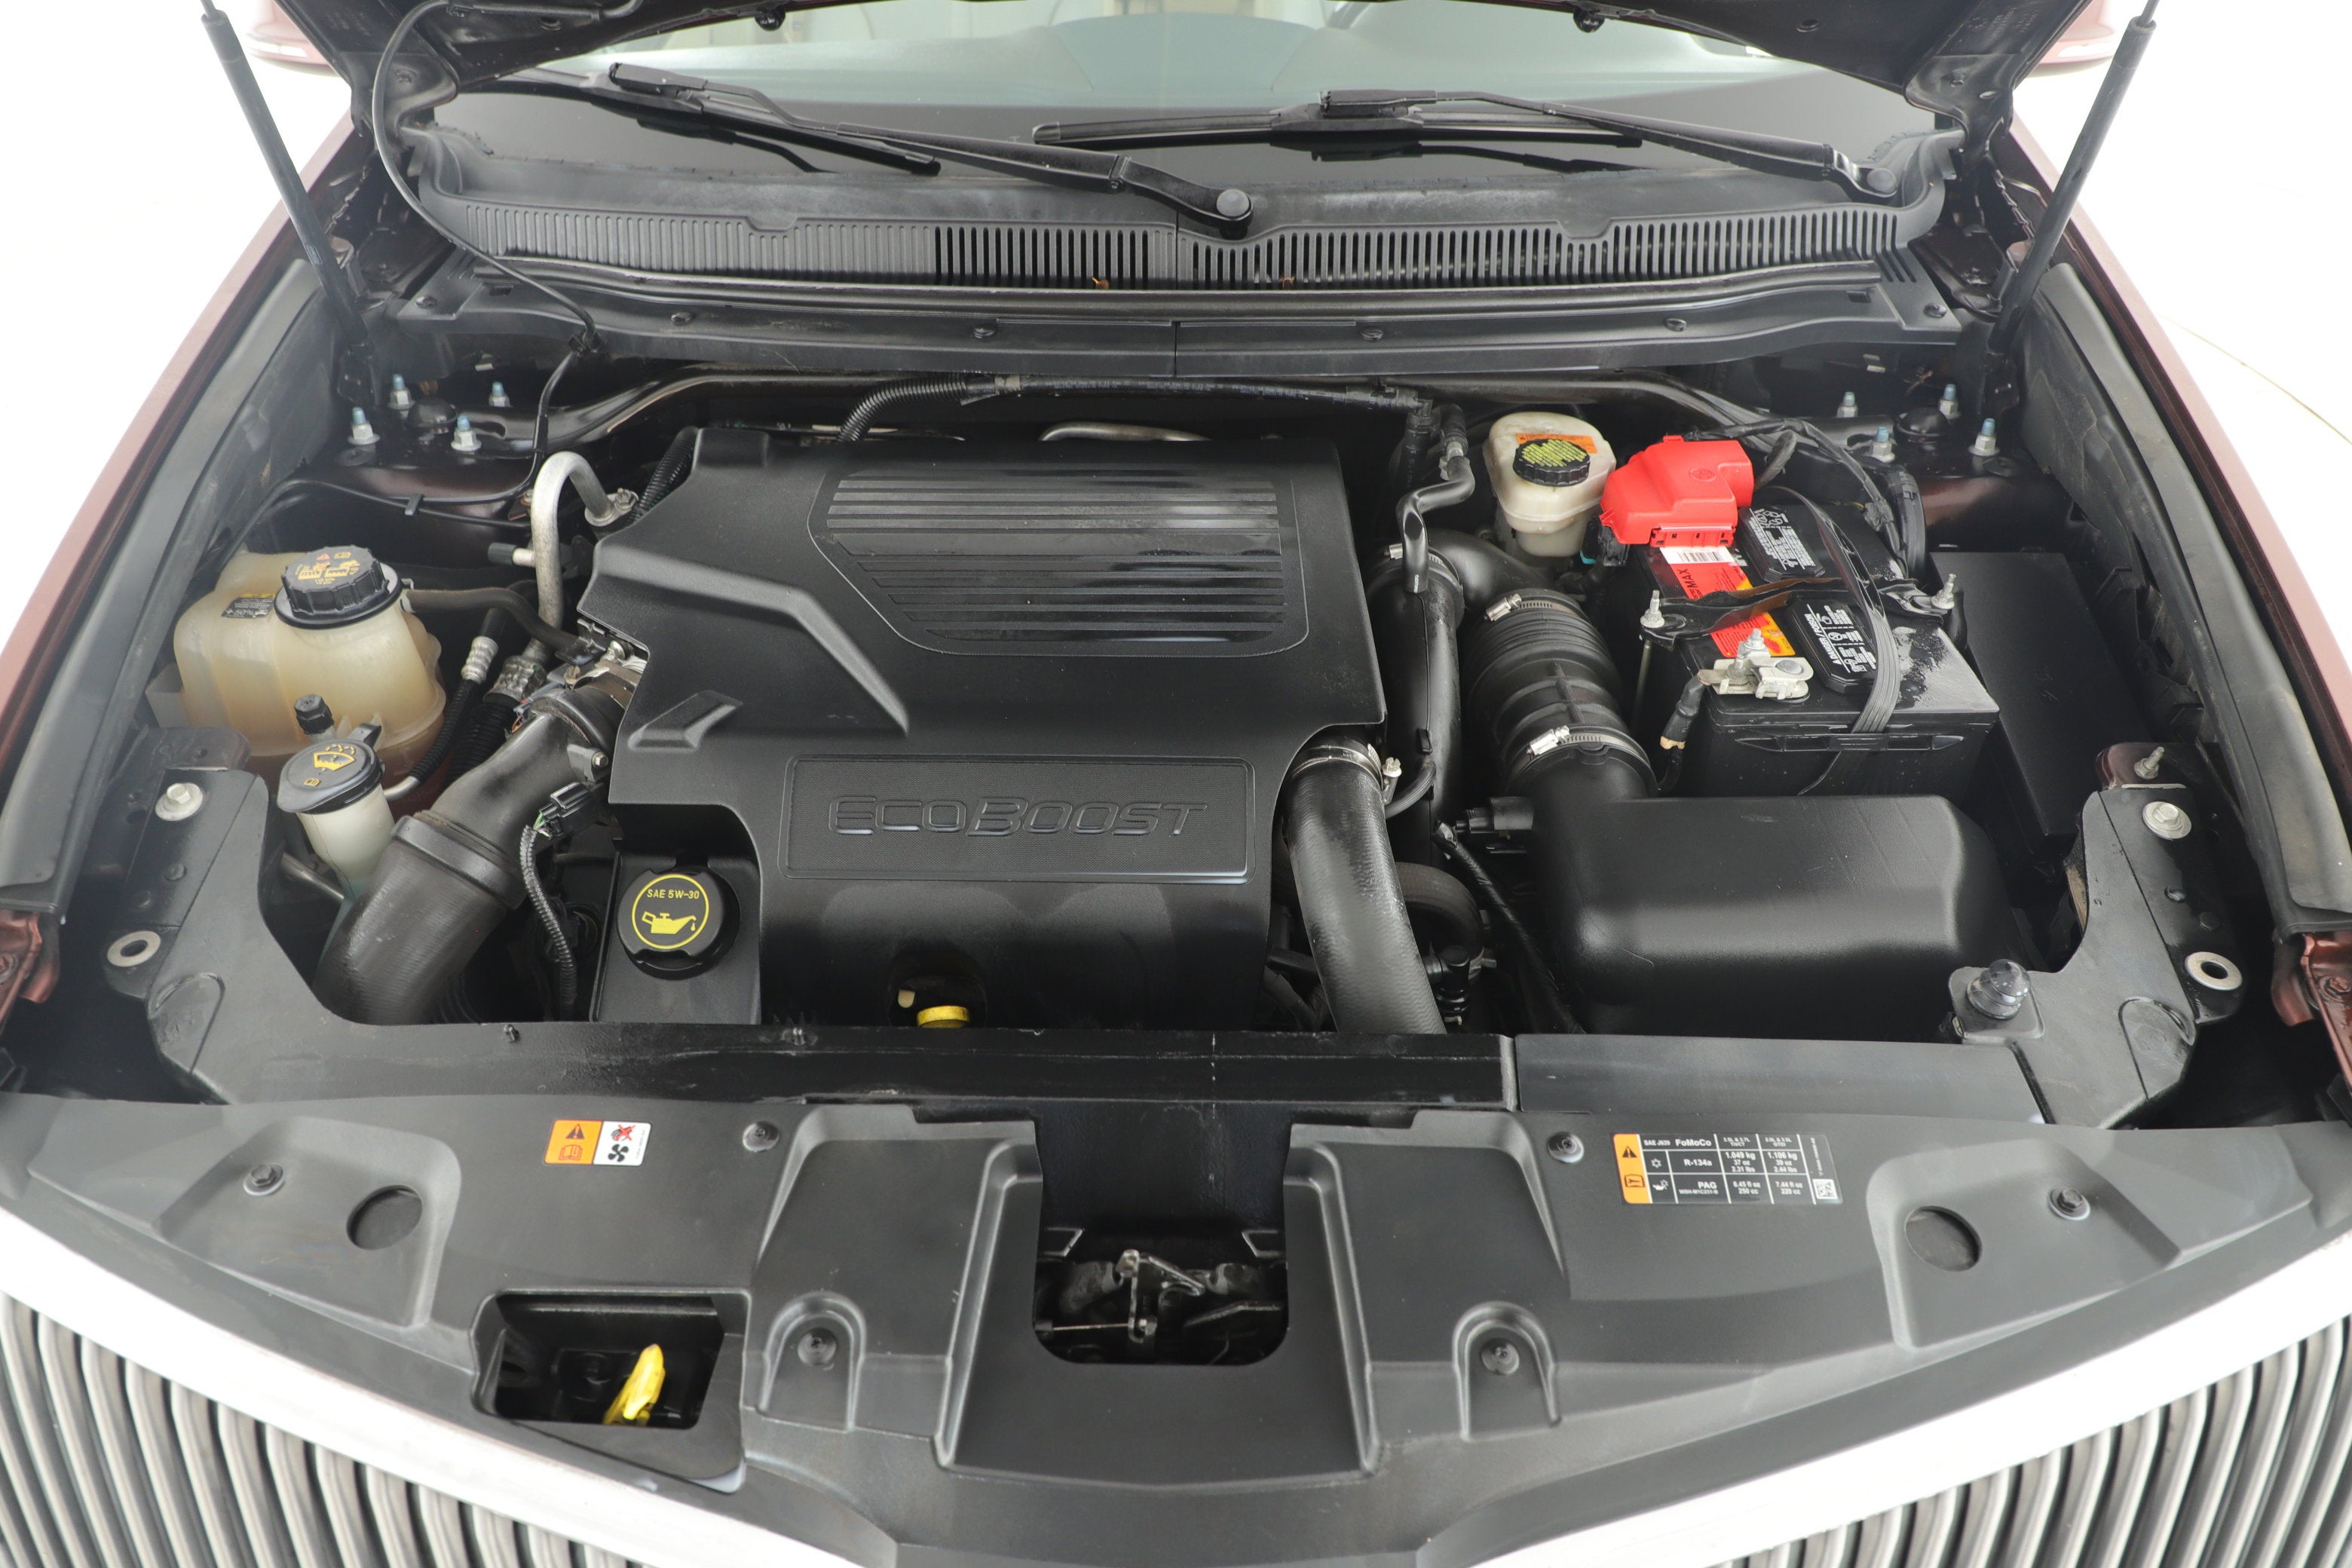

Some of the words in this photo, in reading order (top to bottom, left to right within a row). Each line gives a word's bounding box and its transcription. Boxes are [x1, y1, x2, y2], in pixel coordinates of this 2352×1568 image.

[1677, 568, 1698, 588] MAX
[1804, 613, 1823, 633] POISON
[1818, 637, 1839, 660] DANGER
[646, 889, 666, 899] SAE
[668, 890, 700, 899] 5W-30
[1675, 1138, 1712, 1147] FoMoCo
[1745, 1151, 1756, 1161] kg
[1787, 1151, 1798, 1161] kg
